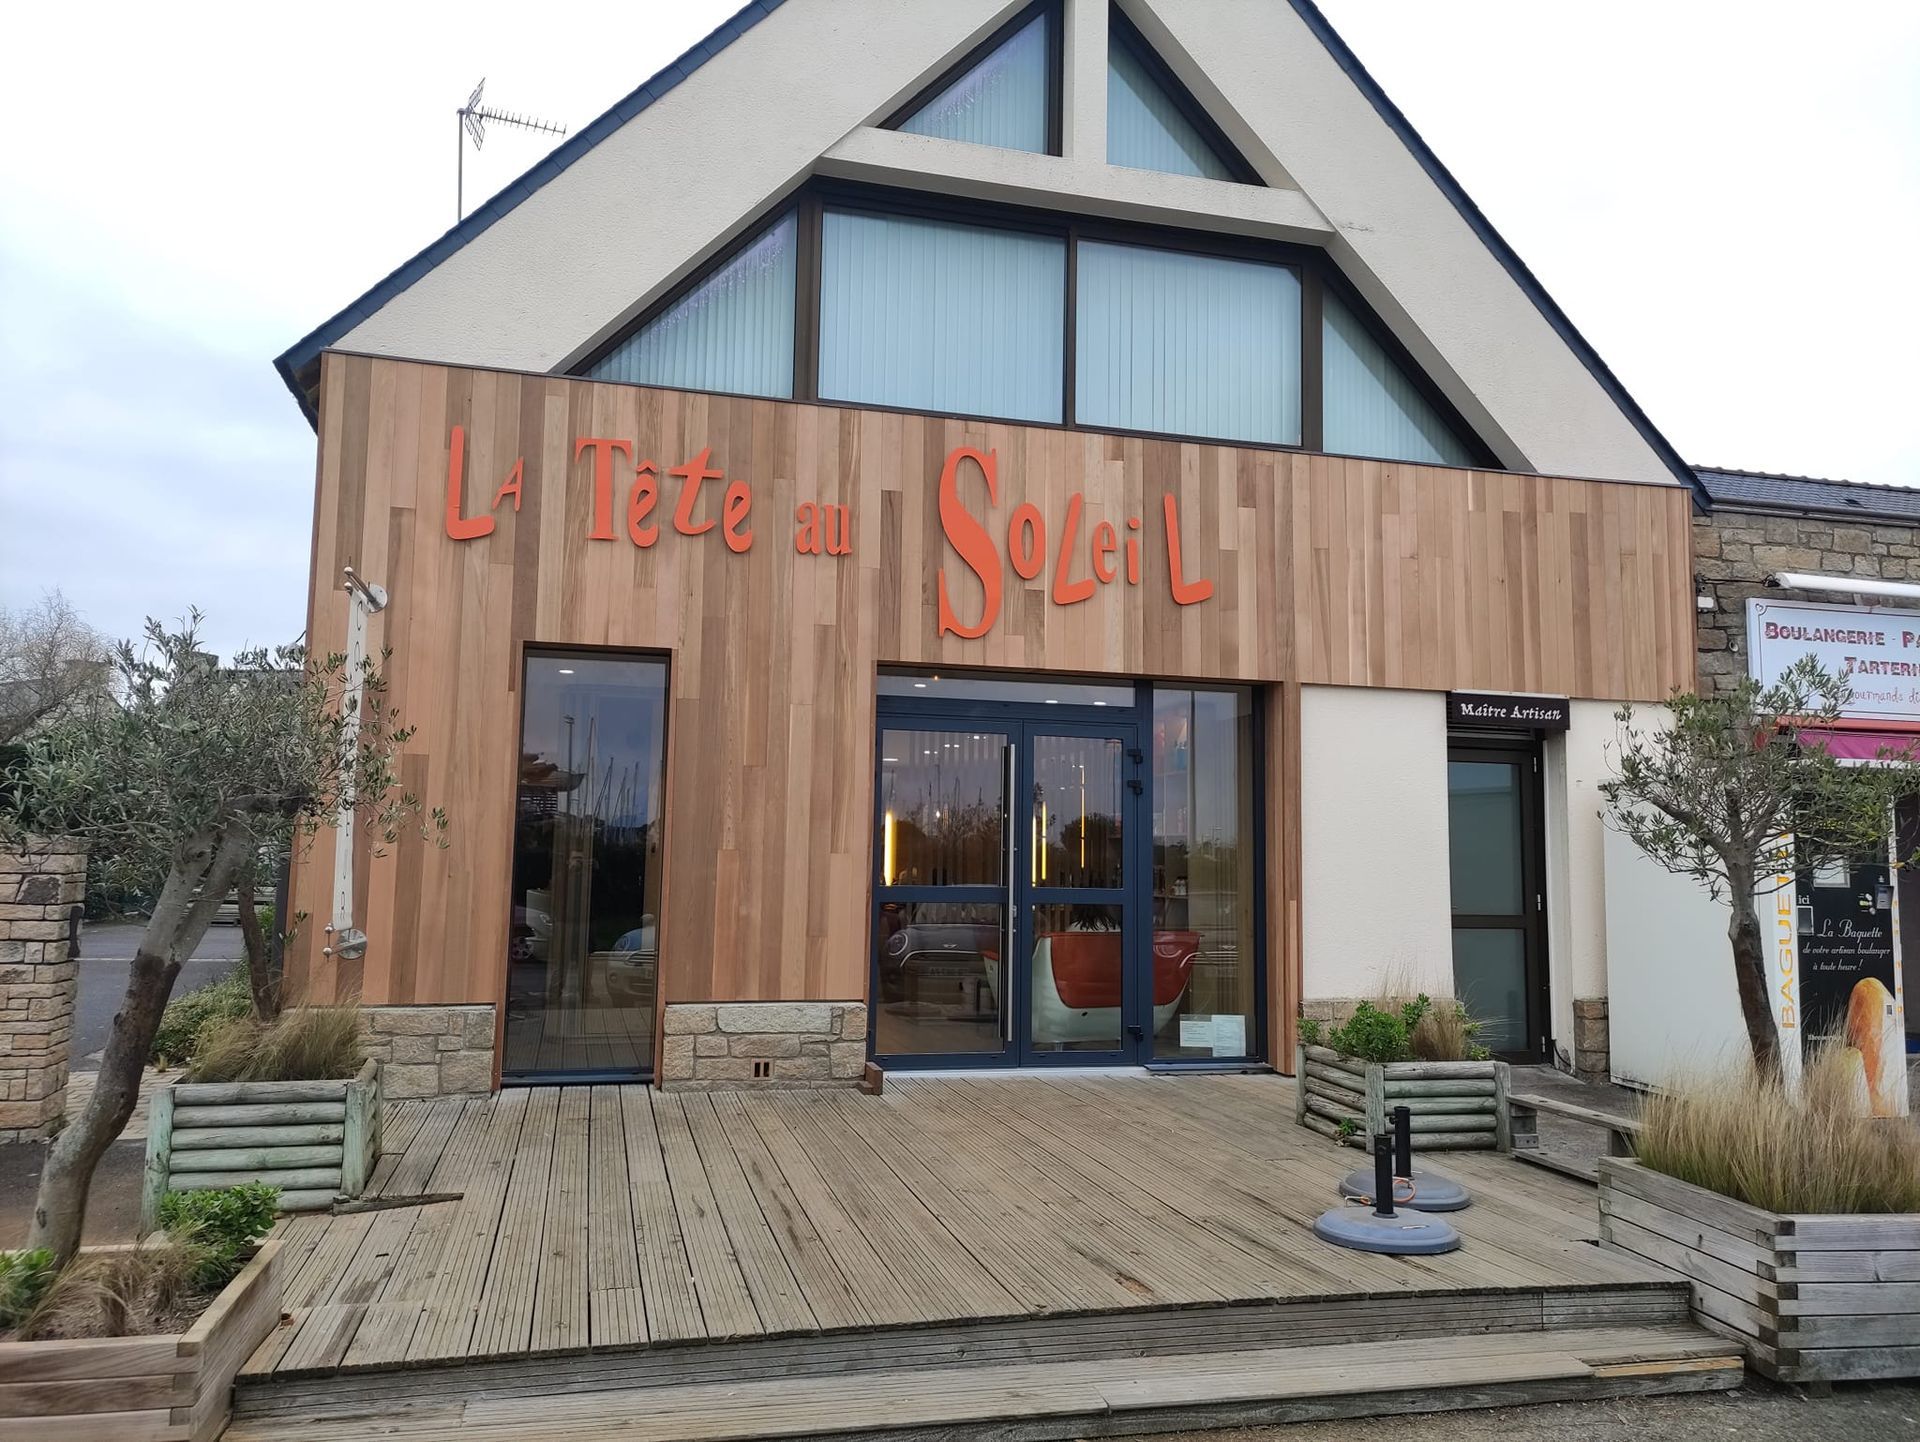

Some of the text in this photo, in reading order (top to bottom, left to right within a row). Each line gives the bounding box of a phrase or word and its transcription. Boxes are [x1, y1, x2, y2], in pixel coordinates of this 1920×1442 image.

[575, 437, 753, 553] Tête
[795, 501, 852, 555] au
[1844, 656, 1920, 676] TARTERI
[1845, 687, 1903, 706] ourmands
[1460, 703, 1562, 721] Maître Artisan
[1798, 895, 1810, 904] ici
[1817, 918, 1882, 944] La Baguette
[1803, 942, 1890, 959] de votre artisan boulanger
[1820, 962, 1836, 971] toute
